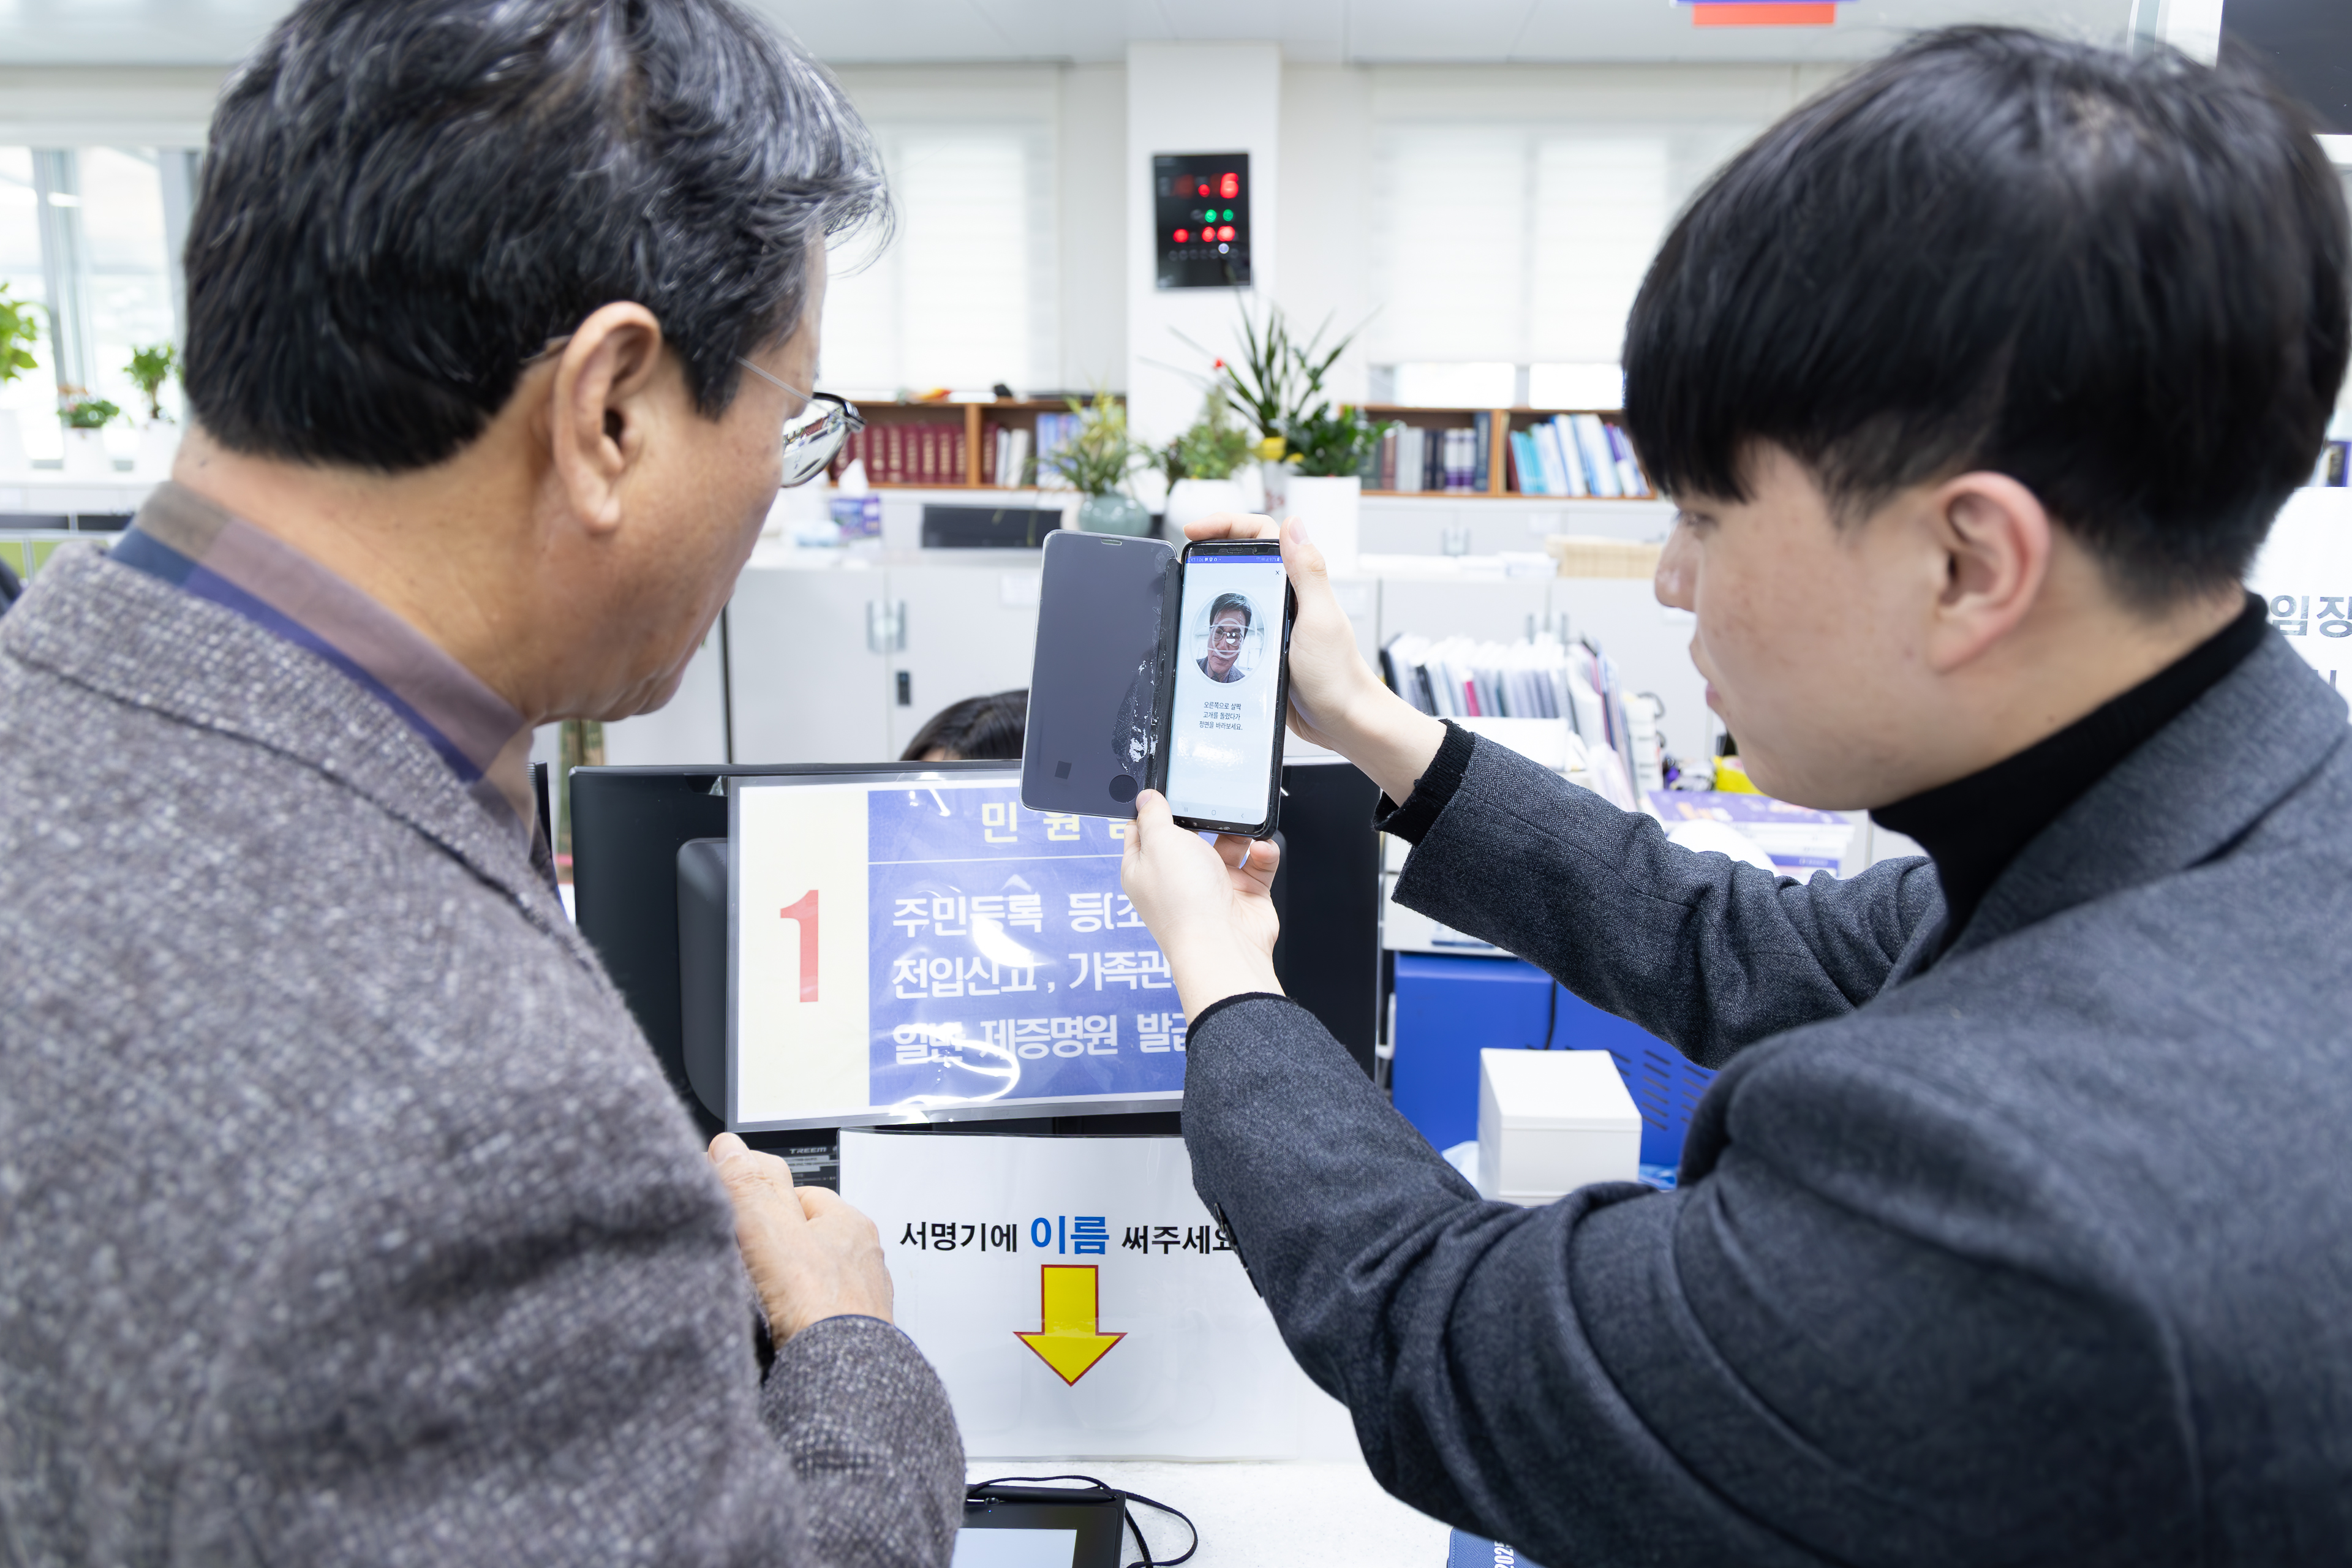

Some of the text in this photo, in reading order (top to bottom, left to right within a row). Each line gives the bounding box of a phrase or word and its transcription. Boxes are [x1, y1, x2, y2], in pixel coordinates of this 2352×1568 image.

[893, 894, 1043, 938] 주민등록
[780, 889, 819, 1003] 1
[1068, 951, 1175, 992] 가족관
[980, 1015, 1118, 1060] 제증명원
[900, 1221, 1017, 1253] 서명기에
[1030, 1215, 1109, 1254] 이름
